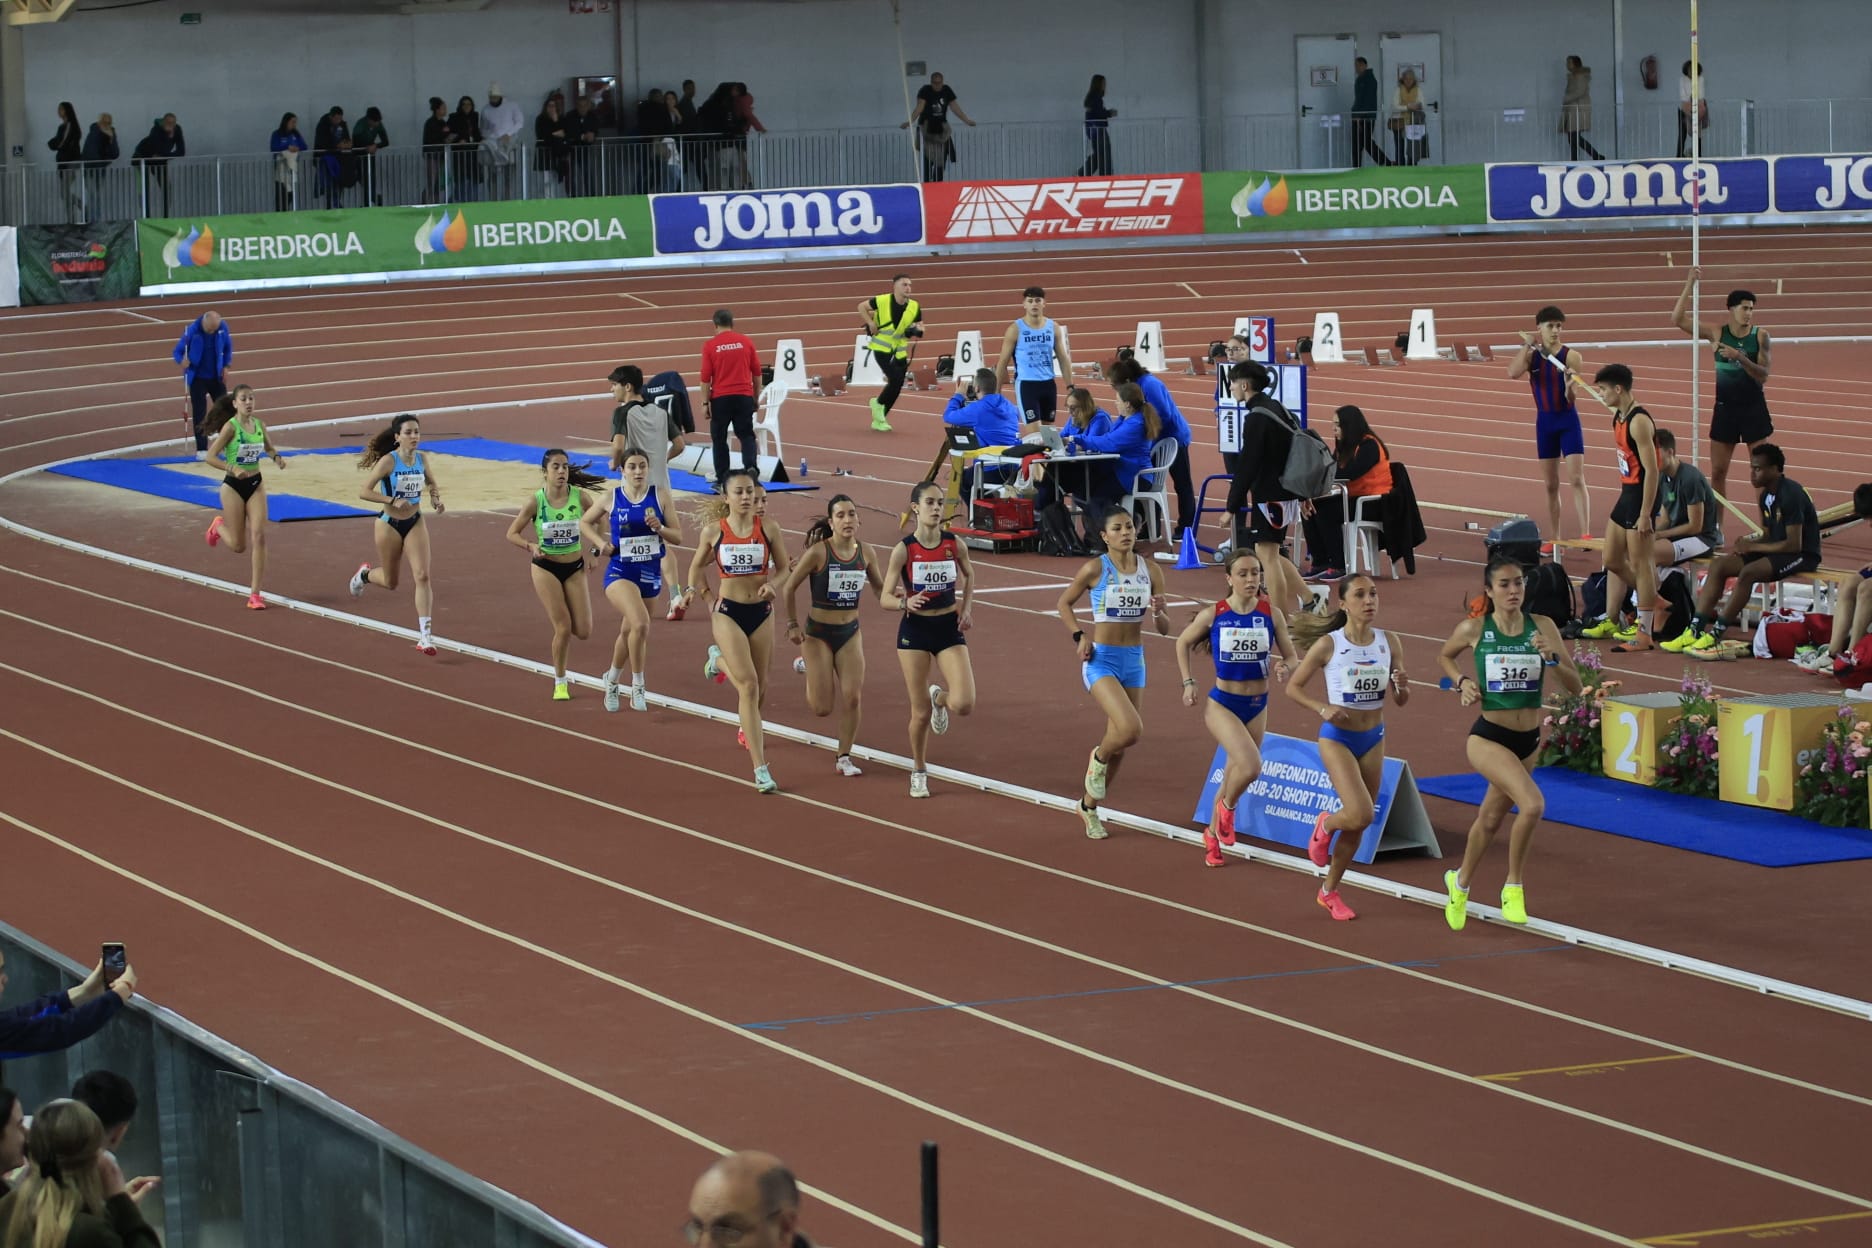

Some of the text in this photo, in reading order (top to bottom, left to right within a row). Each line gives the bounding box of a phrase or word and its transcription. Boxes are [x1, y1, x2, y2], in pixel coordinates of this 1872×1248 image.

[1031, 178, 1184, 217] RFEA
[1295, 185, 1458, 212] IBERDROLA
[1530, 163, 1728, 217] Joma
[694, 190, 883, 249] Joma
[1025, 214, 1173, 235] ATLETISMO
[473, 217, 627, 248] IBERDROLA
[219, 231, 364, 262] IBERDROLA
[1024, 332, 1052, 344] nerja
[1140, 331, 1150, 354] 4
[1252, 319, 1267, 352] 3
[1321, 322, 1334, 345] 2
[1417, 320, 1426, 343] 1
[783, 348, 797, 372] 8
[961, 340, 972, 363] 6
[618, 513, 628, 522] M
[553, 529, 572, 538] 328
[630, 545, 651, 555] 403
[730, 554, 753, 565] 383
[839, 580, 858, 590] 436
[924, 573, 947, 583] 406
[1118, 596, 1142, 608] 394
[1232, 639, 1258, 651] 268
[1354, 678, 1379, 691] 469
[1500, 667, 1528, 681] 316
[1615, 711, 1639, 774] 2
[1743, 713, 1765, 795] 1
[1261, 759, 1319, 787] AMPEONATO
[1247, 779, 1344, 814] SUB-20 SHORT TRAC
[1265, 804, 1302, 822] SALAMANCA
